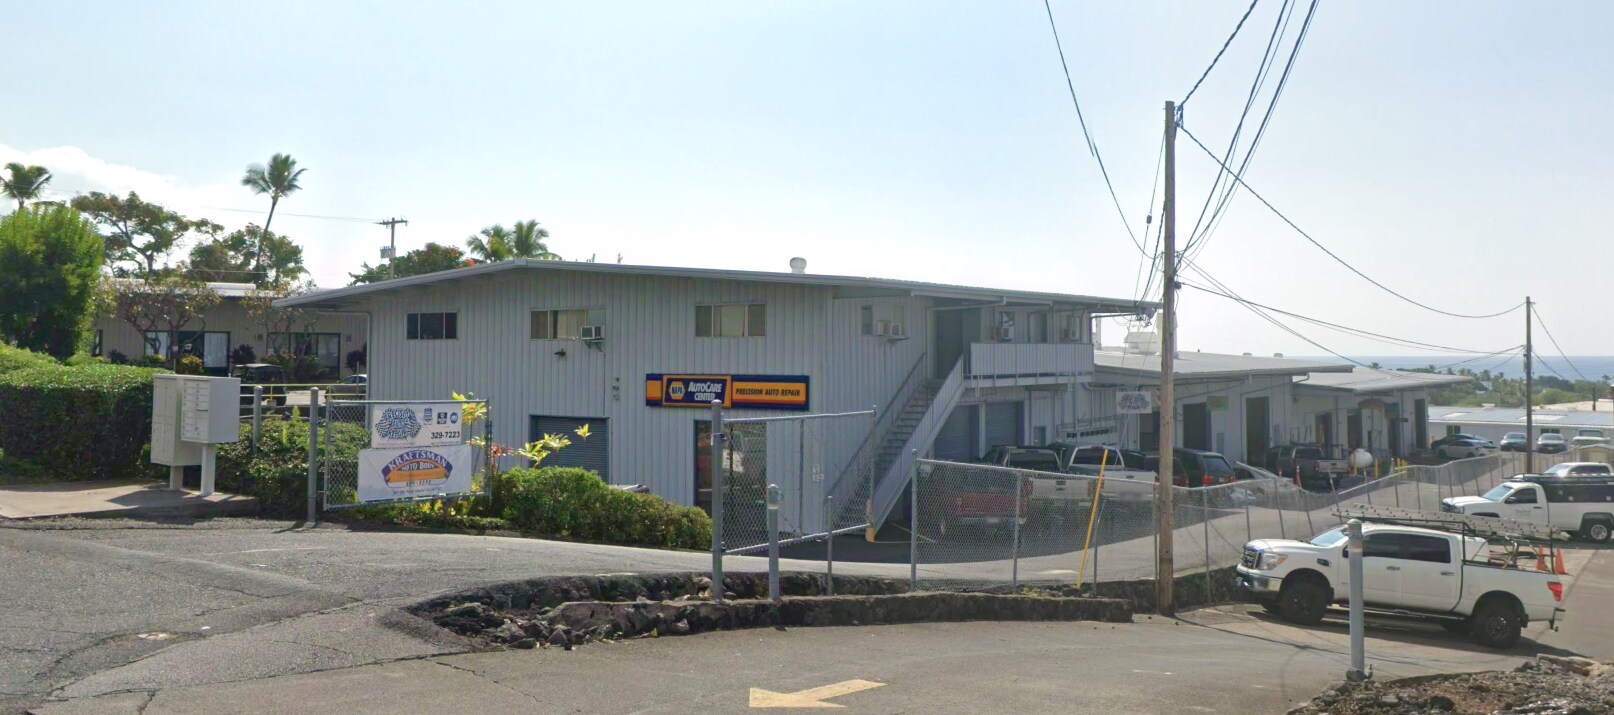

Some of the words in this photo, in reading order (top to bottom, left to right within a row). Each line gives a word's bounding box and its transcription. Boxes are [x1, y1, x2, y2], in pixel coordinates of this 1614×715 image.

[735, 388, 764, 396] PRECISION
[781, 389, 801, 397] REPAIR
[694, 393, 716, 401] CENTER
[431, 431, 460, 439] 329-7223
[389, 450, 447, 470] KRAFTSMAN
